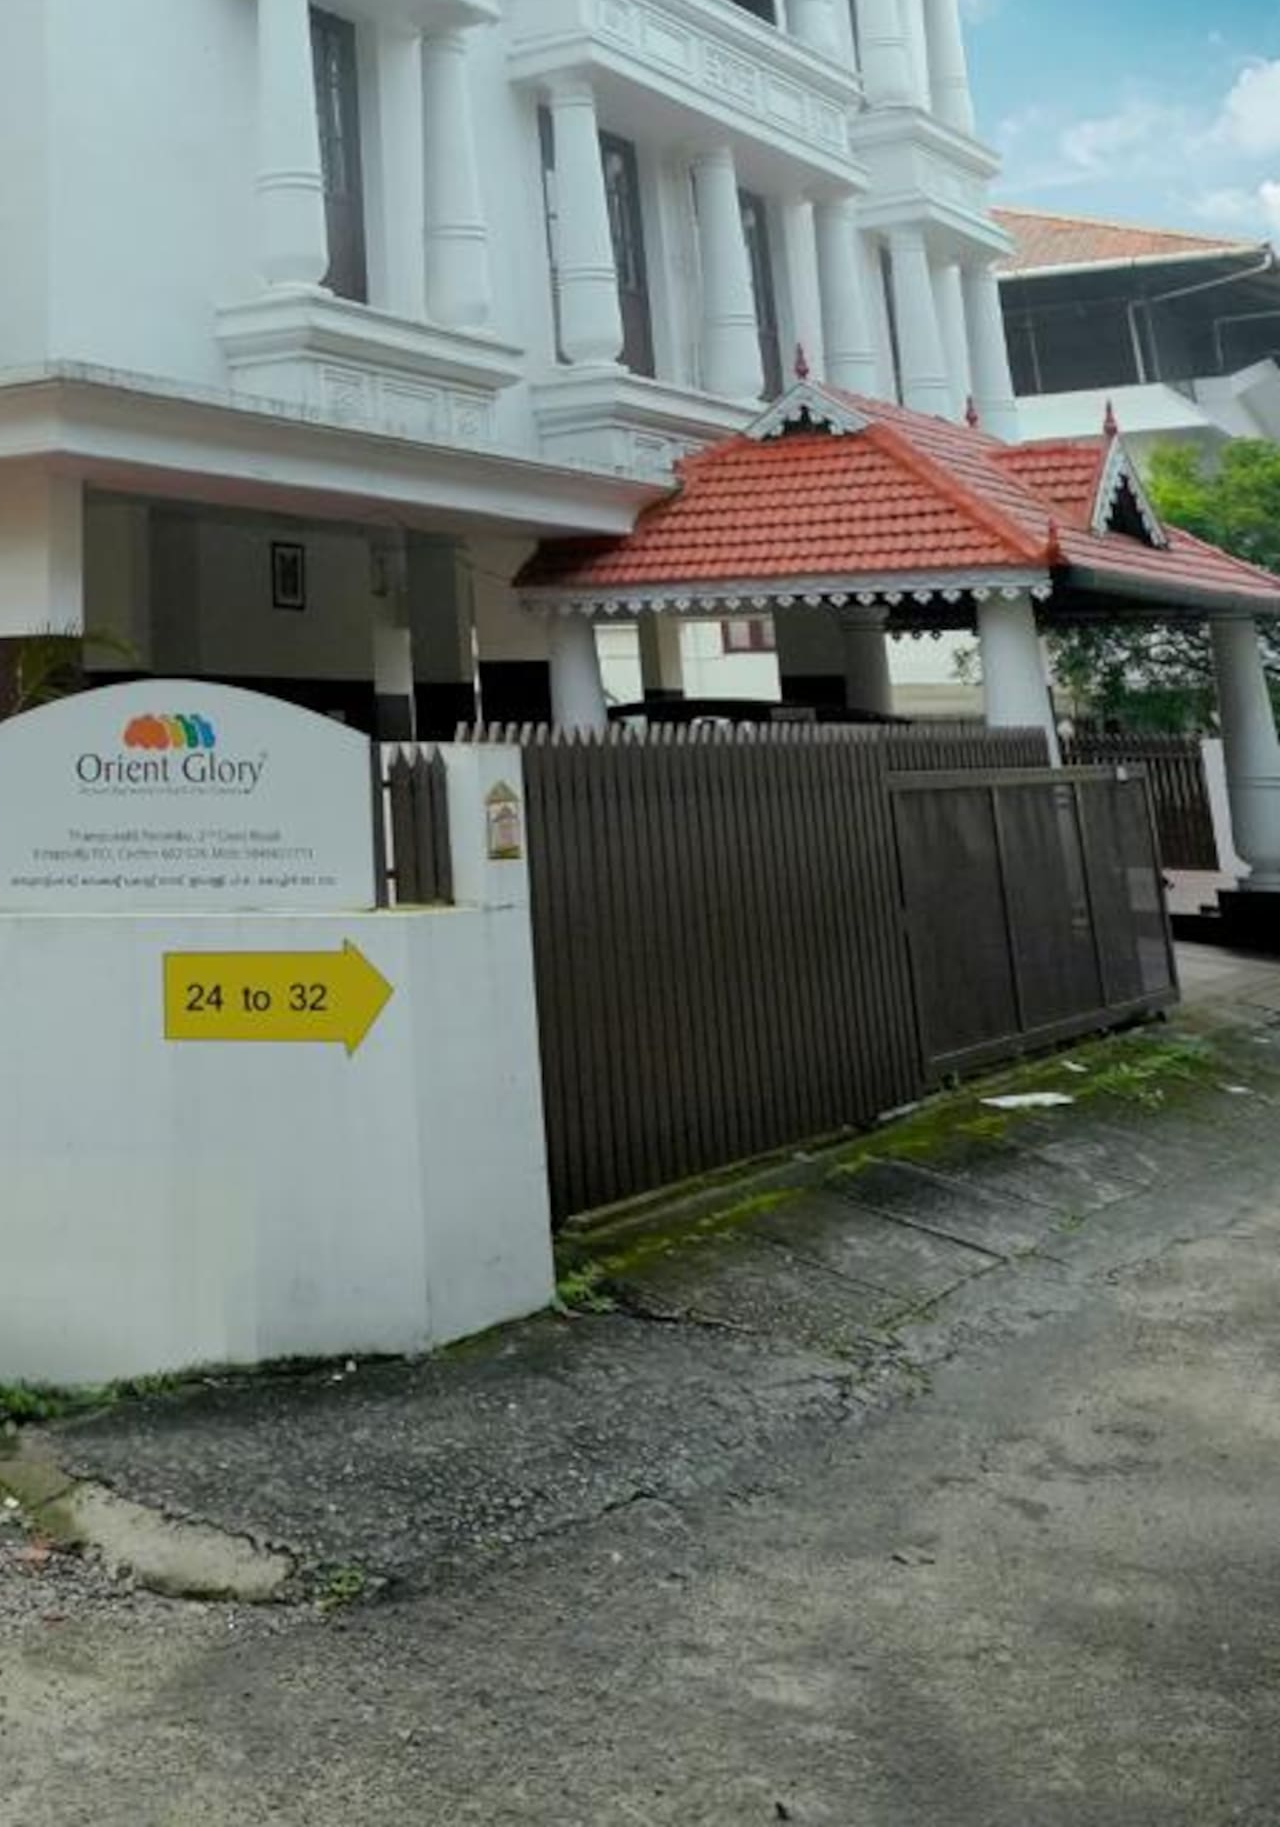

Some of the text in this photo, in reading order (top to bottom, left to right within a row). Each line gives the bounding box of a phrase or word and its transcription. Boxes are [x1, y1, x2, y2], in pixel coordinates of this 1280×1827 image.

[76, 751, 264, 792] Orient Glory
[185, 984, 328, 1012] 24 to 32
